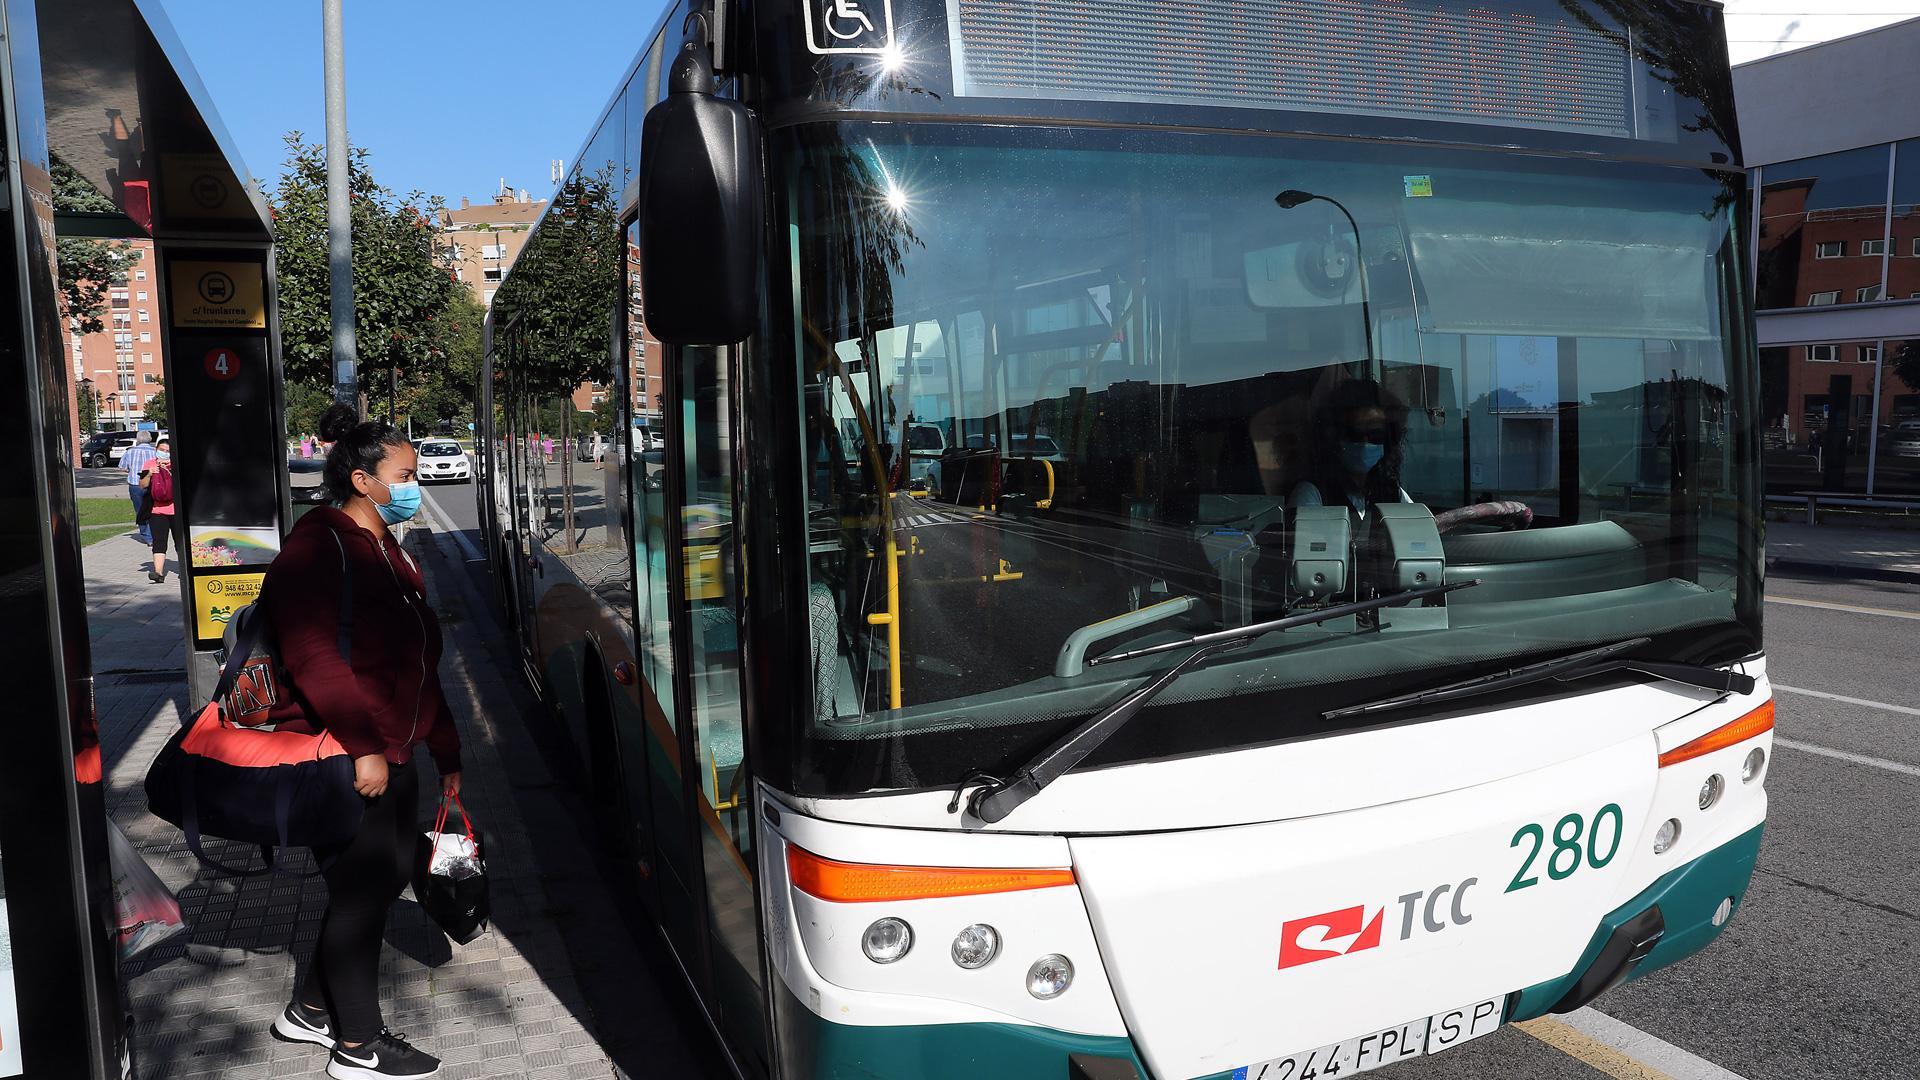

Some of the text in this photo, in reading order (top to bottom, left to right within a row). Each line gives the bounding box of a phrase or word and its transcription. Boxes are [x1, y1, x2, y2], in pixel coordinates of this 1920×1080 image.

[215, 353, 229, 375] 4
[225, 584, 236, 592] 948
[246, 583, 253, 591] 32
[1503, 802, 1623, 894] 280
[1398, 877, 1478, 941] TCC
[1356, 1026, 1416, 1069] FPL
